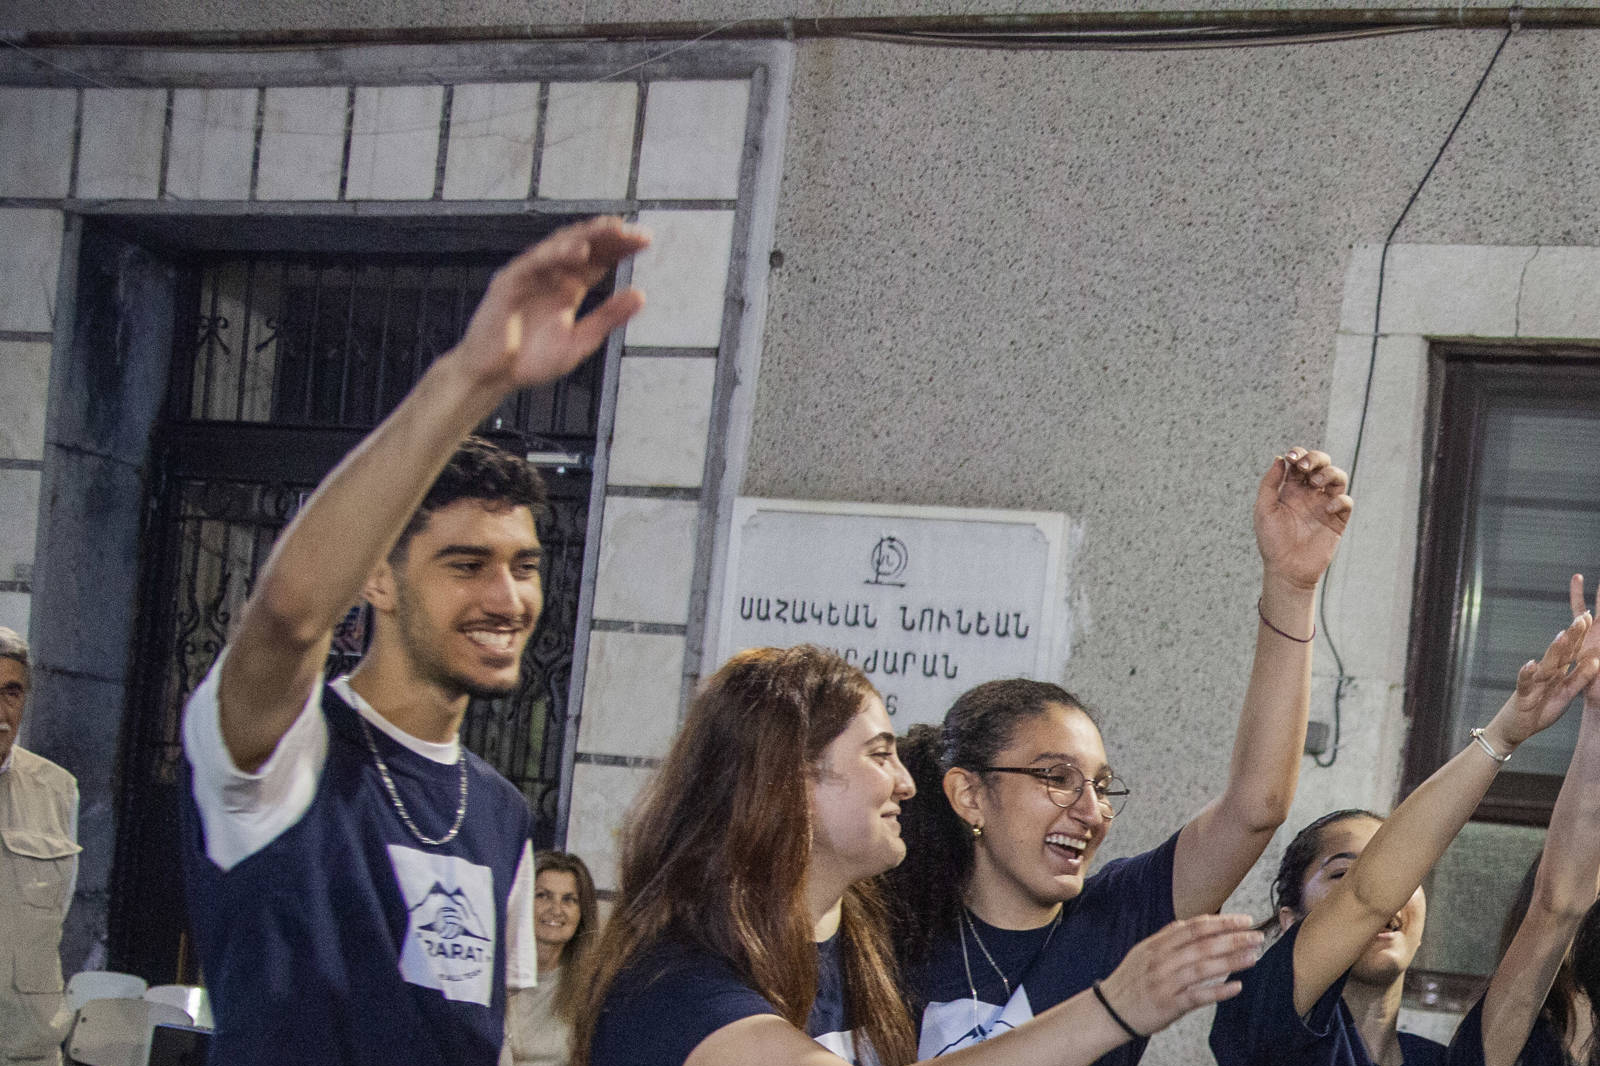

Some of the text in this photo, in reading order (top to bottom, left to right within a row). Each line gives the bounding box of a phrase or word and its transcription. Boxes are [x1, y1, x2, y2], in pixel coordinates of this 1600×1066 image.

[740, 596, 1029, 639] ՍԱՀԱԿԵԱՆ ՆՈՒՆԵԱՆ
[830, 648, 958, 679] ՐԺԱՐԱՆ
